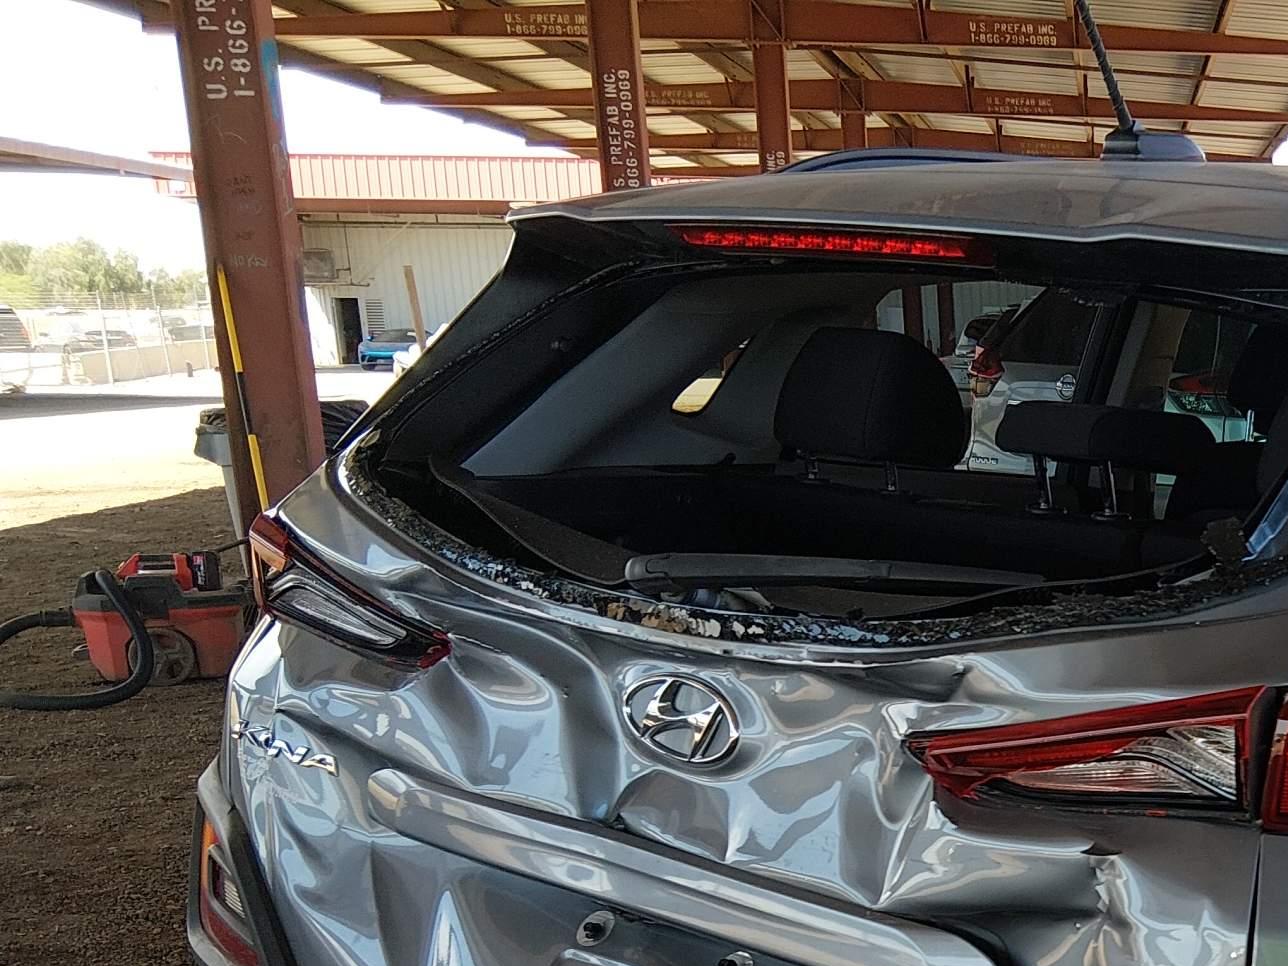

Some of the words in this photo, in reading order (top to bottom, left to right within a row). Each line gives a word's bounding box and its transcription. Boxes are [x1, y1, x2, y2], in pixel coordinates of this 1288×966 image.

[224, 0, 255, 96] 1-866-
[969, 21, 989, 33] U.S.
[994, 22, 1034, 35] PREFAB
[1038, 25, 1057, 35] INC.
[202, 48, 228, 99] U.S.
[603, 69, 617, 98] INC.
[606, 105, 623, 165] PREFAB
